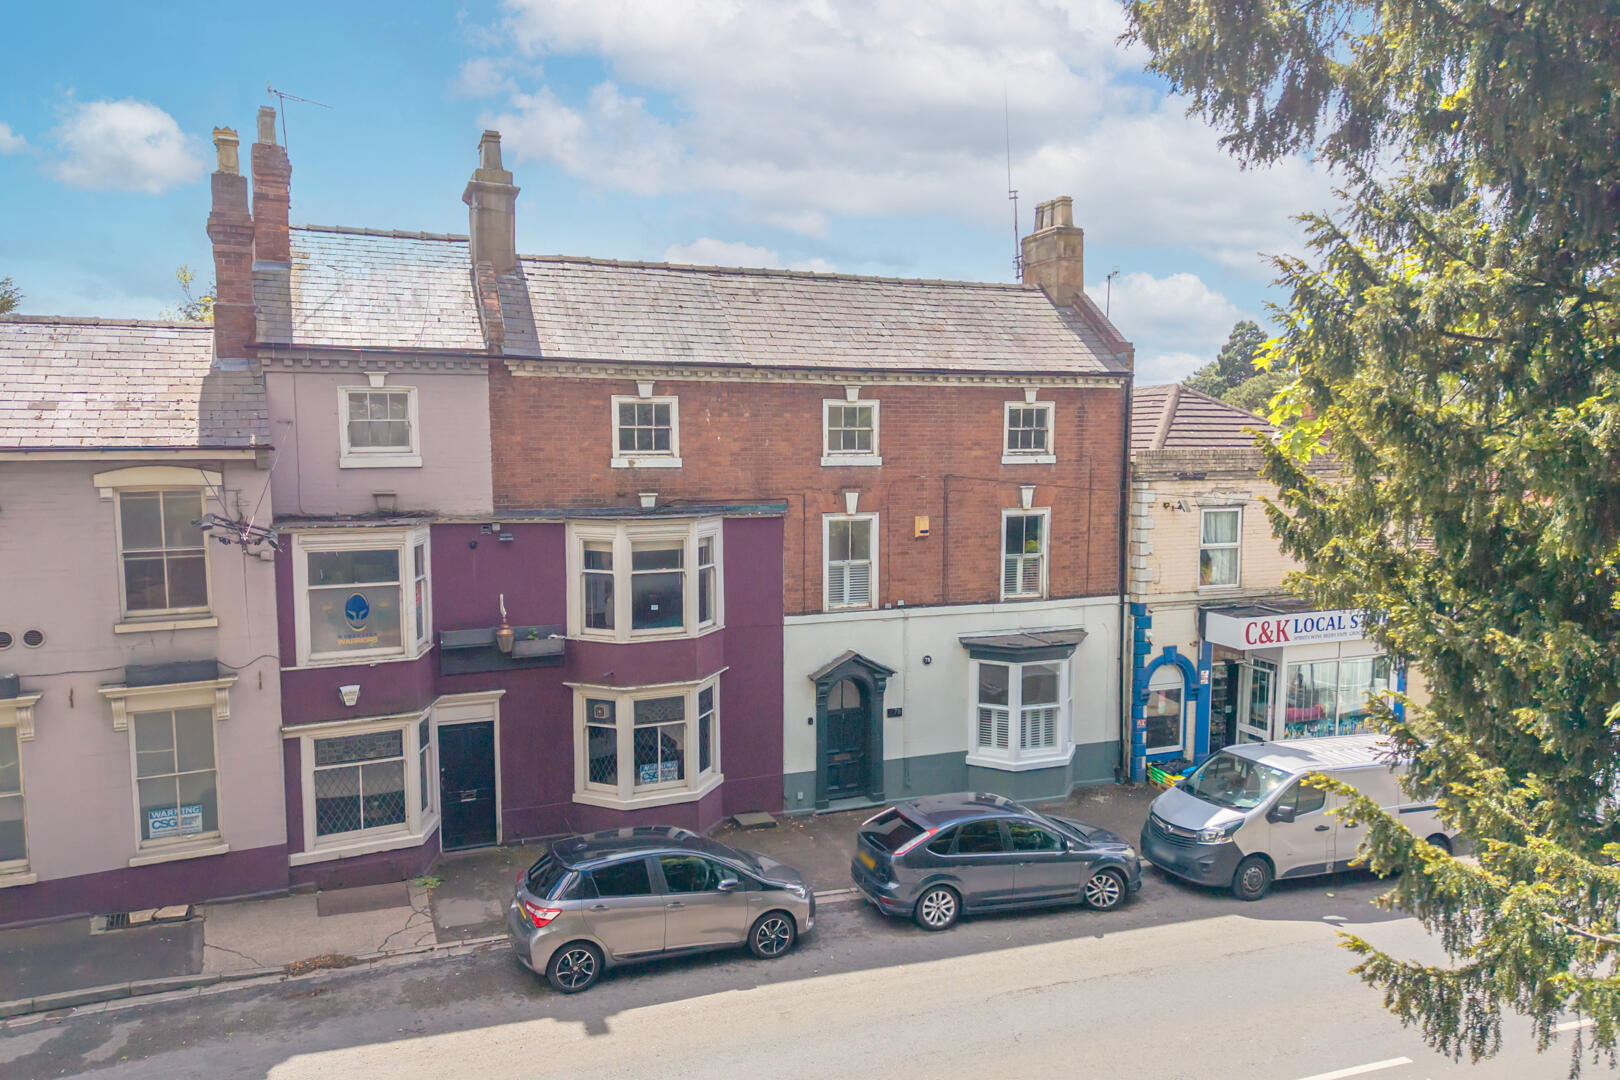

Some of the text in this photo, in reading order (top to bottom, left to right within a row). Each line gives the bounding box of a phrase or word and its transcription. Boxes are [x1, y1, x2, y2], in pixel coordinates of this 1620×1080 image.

[1245, 620, 1290, 645] C&K
[1294, 615, 1346, 634] LOCAL
[152, 817, 177, 829] CSG
